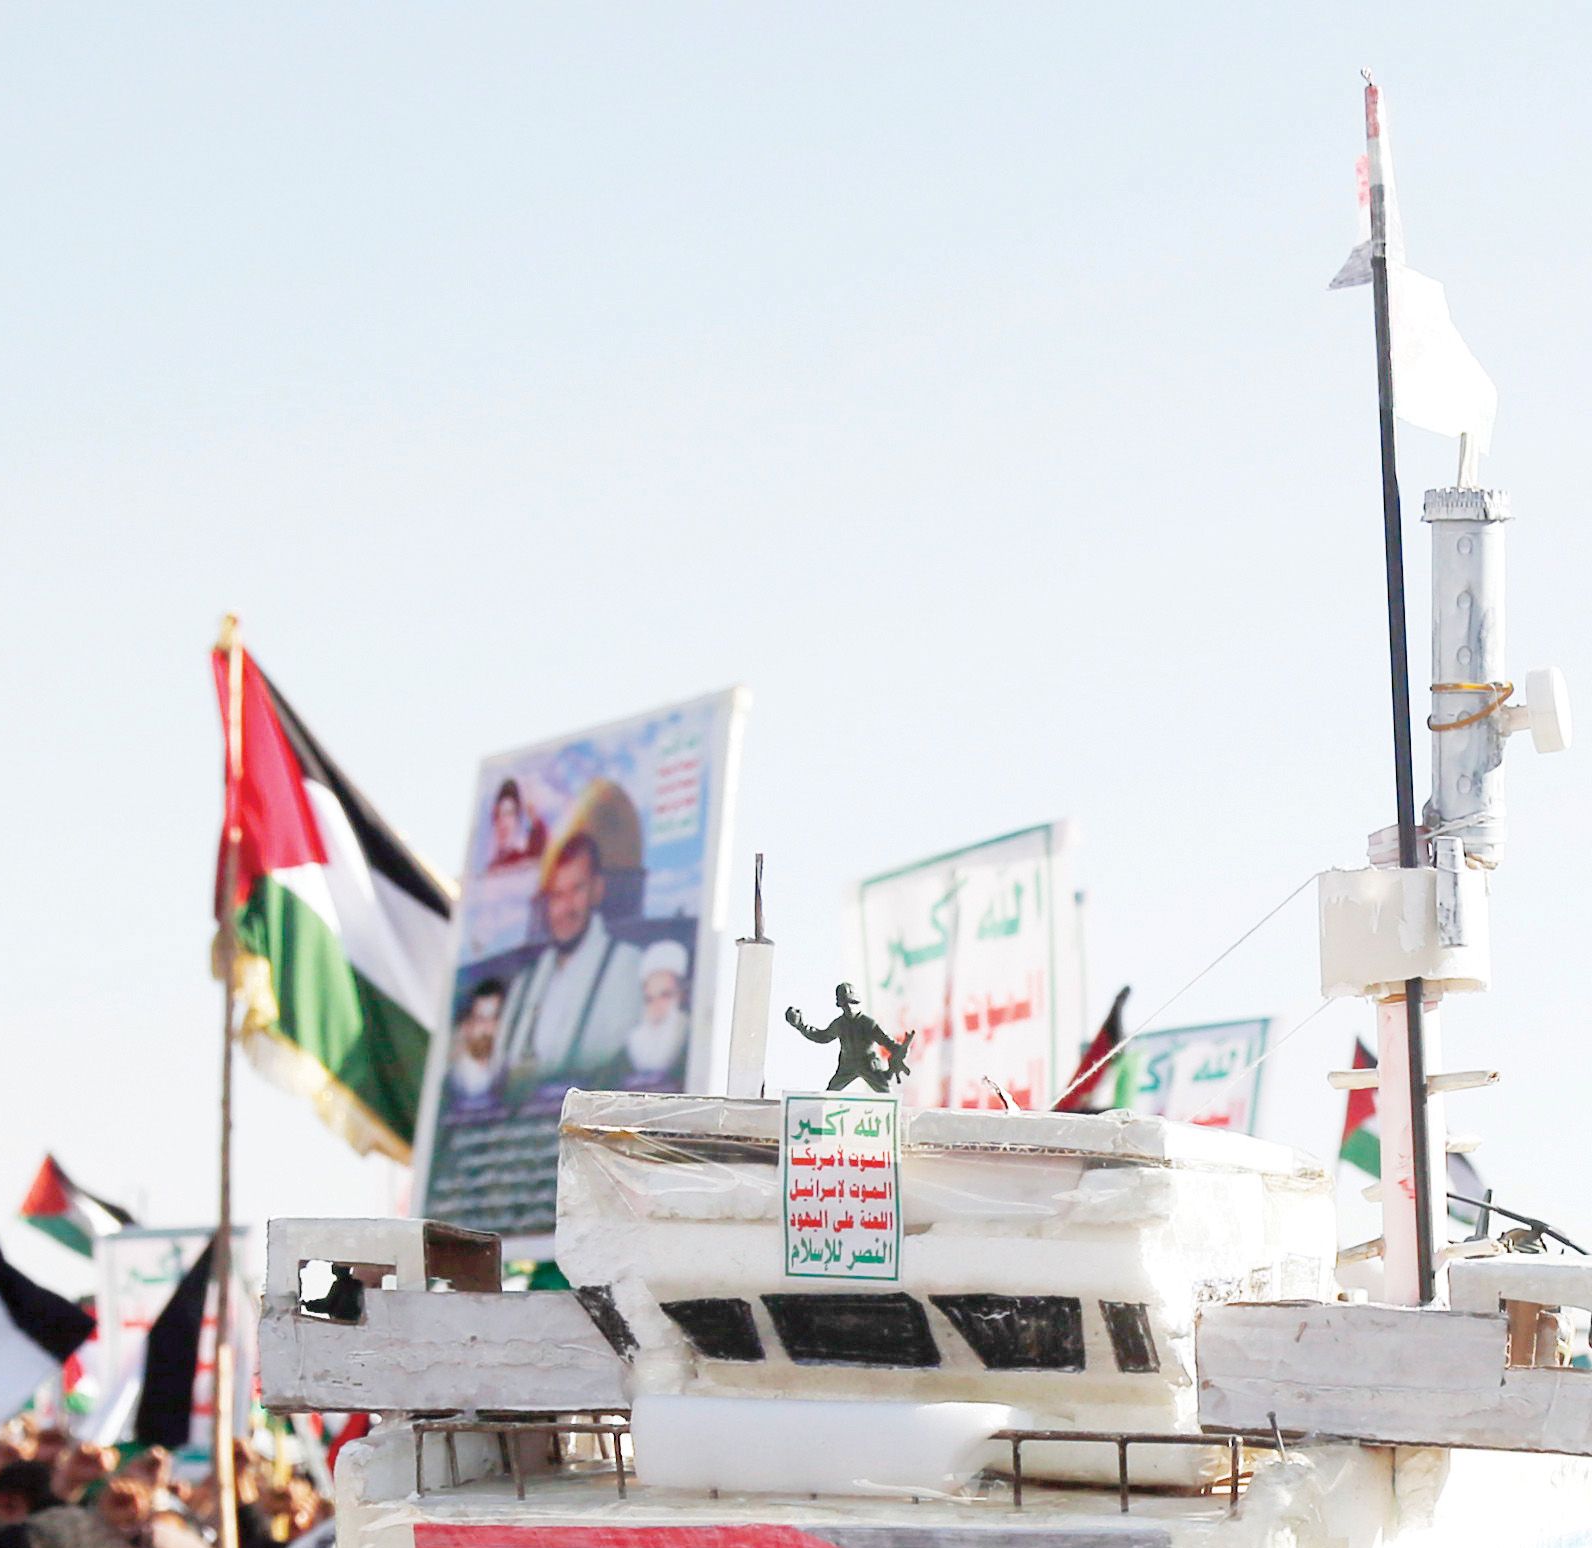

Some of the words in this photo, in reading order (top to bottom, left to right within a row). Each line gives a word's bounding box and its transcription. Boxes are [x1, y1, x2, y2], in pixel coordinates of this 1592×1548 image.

[791, 1104, 851, 1144] أكبر
[854, 1110, 891, 1138] الله
[790, 1144, 844, 1172] لأمريكا
[849, 1150, 891, 1174] الموت
[789, 1178, 844, 1204] لإسرائيل
[849, 1181, 892, 1204] الموت
[790, 1210, 828, 1233] اليهود
[833, 1209, 854, 1233] على
[860, 1209, 893, 1231] اللعنة
[791, 1236, 842, 1271] للإسلام
[847, 1237, 893, 1271] النصر
